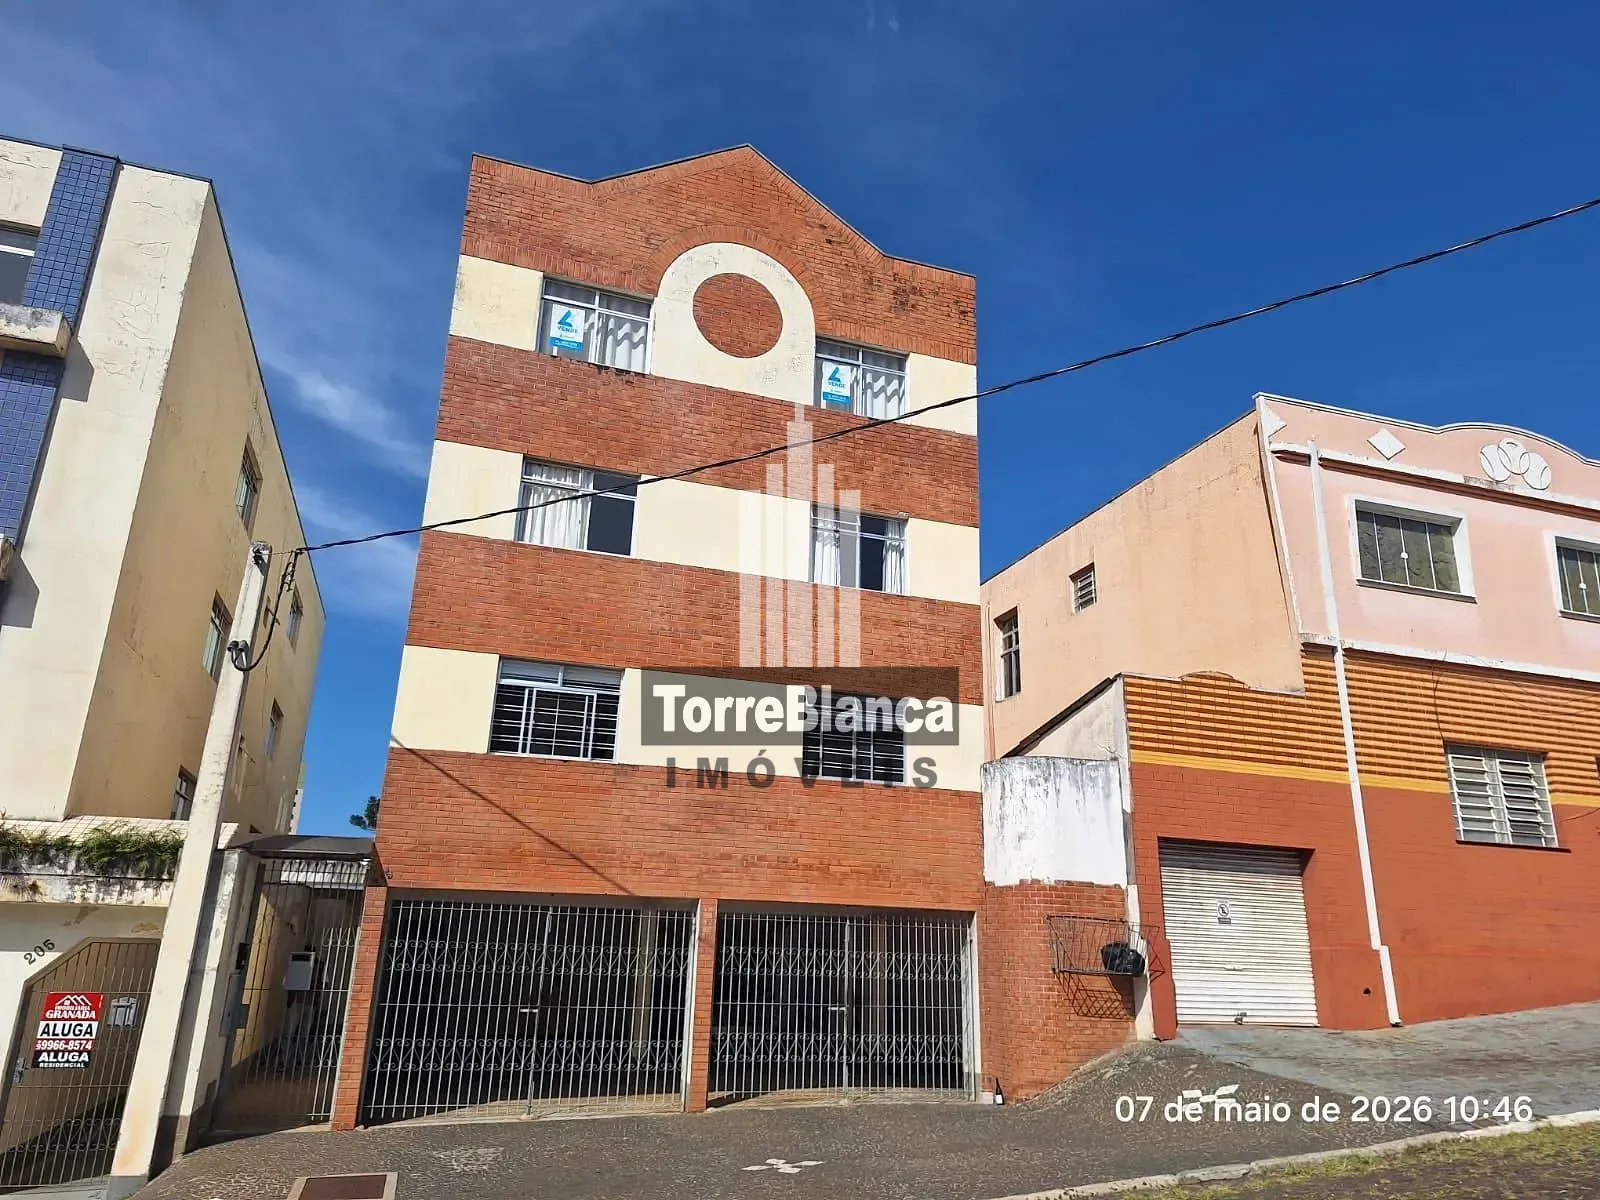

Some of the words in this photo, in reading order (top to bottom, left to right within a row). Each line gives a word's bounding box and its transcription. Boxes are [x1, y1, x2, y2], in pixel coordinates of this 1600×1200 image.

[23, 938, 56, 966] 205
[45, 1009, 96, 1019] GRANADA
[39, 1022, 94, 1037] ALUGA
[38, 1051, 90, 1062] ALUGA
